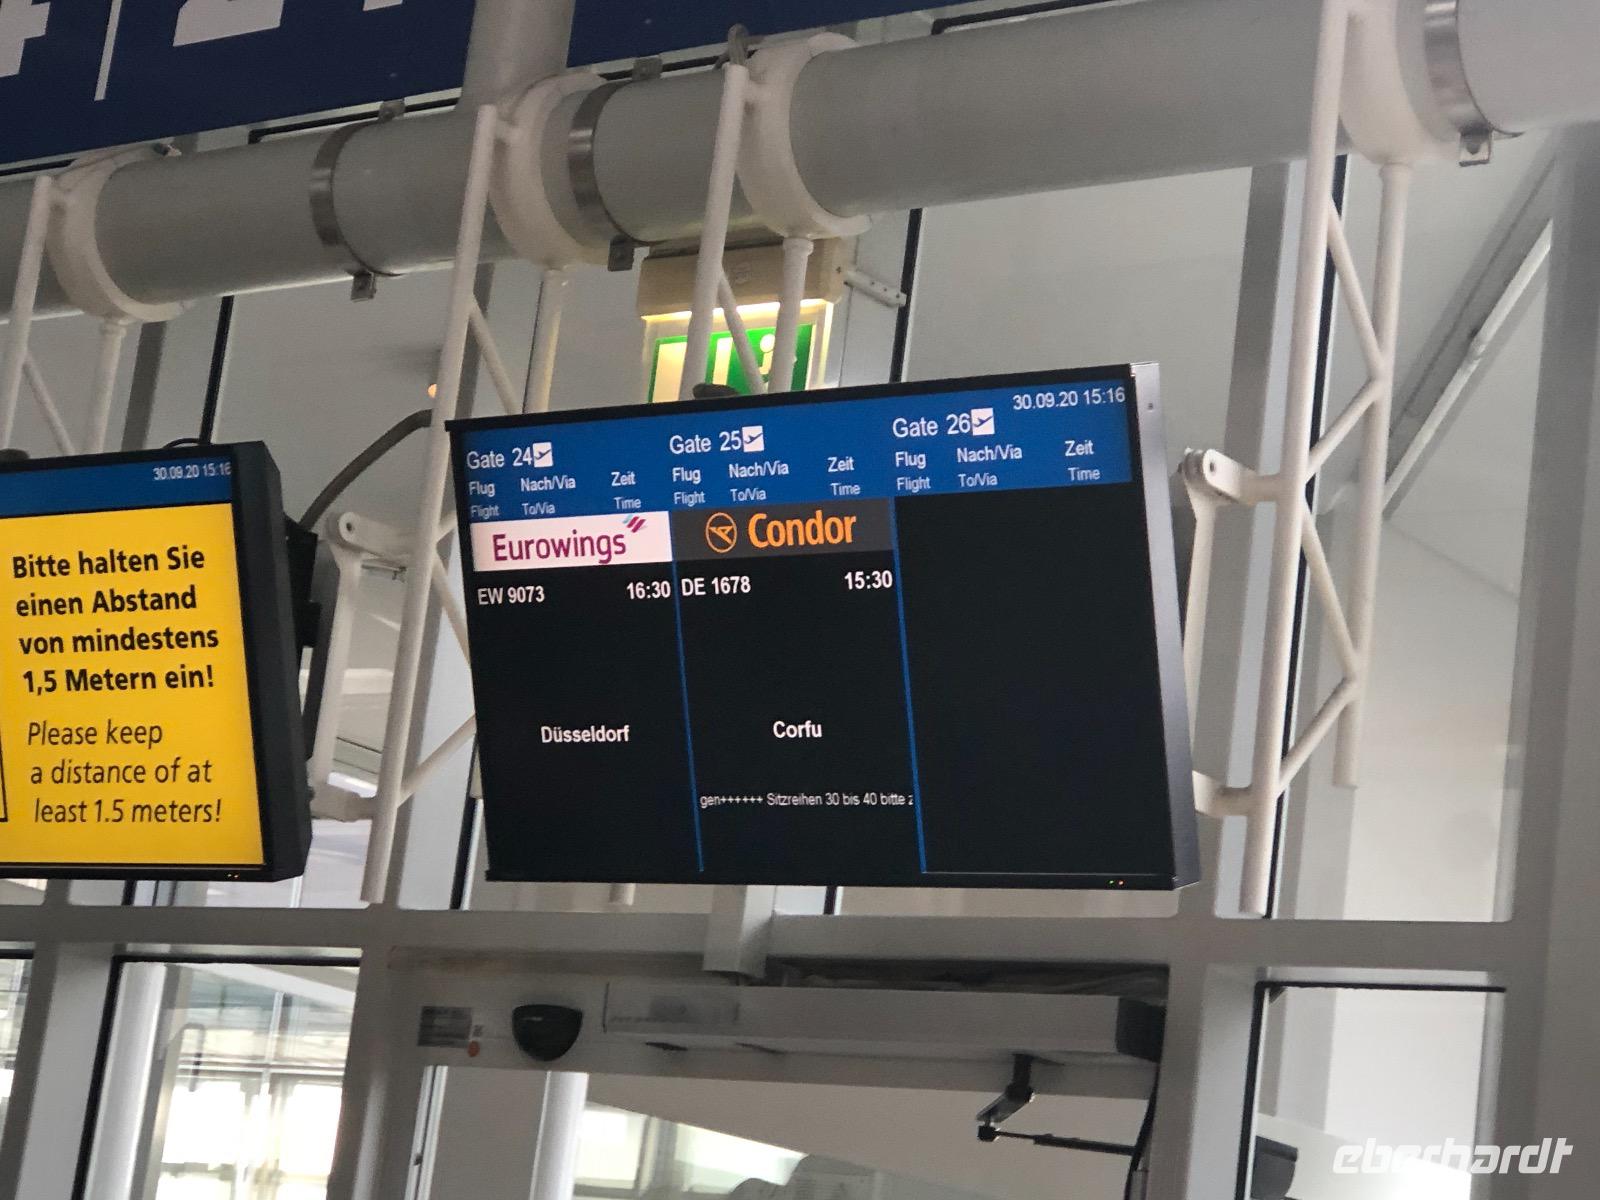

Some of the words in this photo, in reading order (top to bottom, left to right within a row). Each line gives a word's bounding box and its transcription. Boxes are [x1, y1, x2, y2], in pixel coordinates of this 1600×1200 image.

[1013, 391, 1078, 410] 30.09.20
[1083, 386, 1126, 404] 15:16
[892, 417, 938, 438] Gate
[946, 414, 971, 436] 26
[670, 434, 712, 454] Gate
[719, 431, 742, 451] 25
[895, 451, 926, 469] Flug
[956, 444, 1022, 462] Nach/Via
[1064, 440, 1094, 456] Zeit
[466, 450, 504, 470] Gate
[512, 448, 532, 466] 24
[672, 467, 702, 484] Flug
[729, 460, 789, 478] Nach/Via
[828, 456, 854, 472] Zeit
[152, 464, 200, 480] 30.09.20
[469, 481, 496, 496] Flug
[520, 475, 576, 492] Nach/Via
[611, 471, 636, 486] Zeit
[896, 476, 931, 493] Flight
[958, 473, 998, 488] To/Via
[1068, 467, 1100, 482] Time
[674, 492, 706, 507] Flight
[730, 488, 766, 502] To/Via
[830, 482, 861, 496] Time
[470, 504, 500, 520] Flight
[522, 502, 555, 516] To/Via
[614, 496, 641, 510] Time
[748, 510, 856, 548] Condor
[492, 529, 626, 565] Eurowings
[13, 554, 70, 579] Bitte
[78, 549, 158, 575] halten
[166, 544, 204, 570] Sie
[478, 588, 503, 605] EW
[508, 586, 544, 604] 9073
[626, 580, 671, 600] 16:30
[682, 578, 706, 596] DE
[712, 576, 751, 595] 1678
[844, 570, 893, 590] 15:30
[16, 592, 83, 617] einen
[92, 584, 196, 613] Abstand
[19, 636, 64, 654] von
[72, 626, 220, 652] mindestens
[23, 670, 57, 696] 1,5
[66, 668, 156, 692] Metern
[165, 664, 214, 688] ein!
[28, 720, 98, 746] Please
[106, 718, 162, 750] keep
[540, 725, 630, 744] Düsseldorf
[773, 720, 822, 739] Corfu
[31, 766, 42, 784] a
[51, 758, 146, 784] distance
[155, 757, 181, 782] of
[188, 760, 212, 782] at
[34, 798, 88, 822] least
[94, 798, 124, 822] 1.5
[132, 798, 222, 822] meters!
[766, 792, 822, 806] Sitzreihen
[825, 792, 840, 806] 30
[842, 792, 860, 806] bis
[862, 792, 878, 806] 40
[880, 792, 906, 806] bitte
